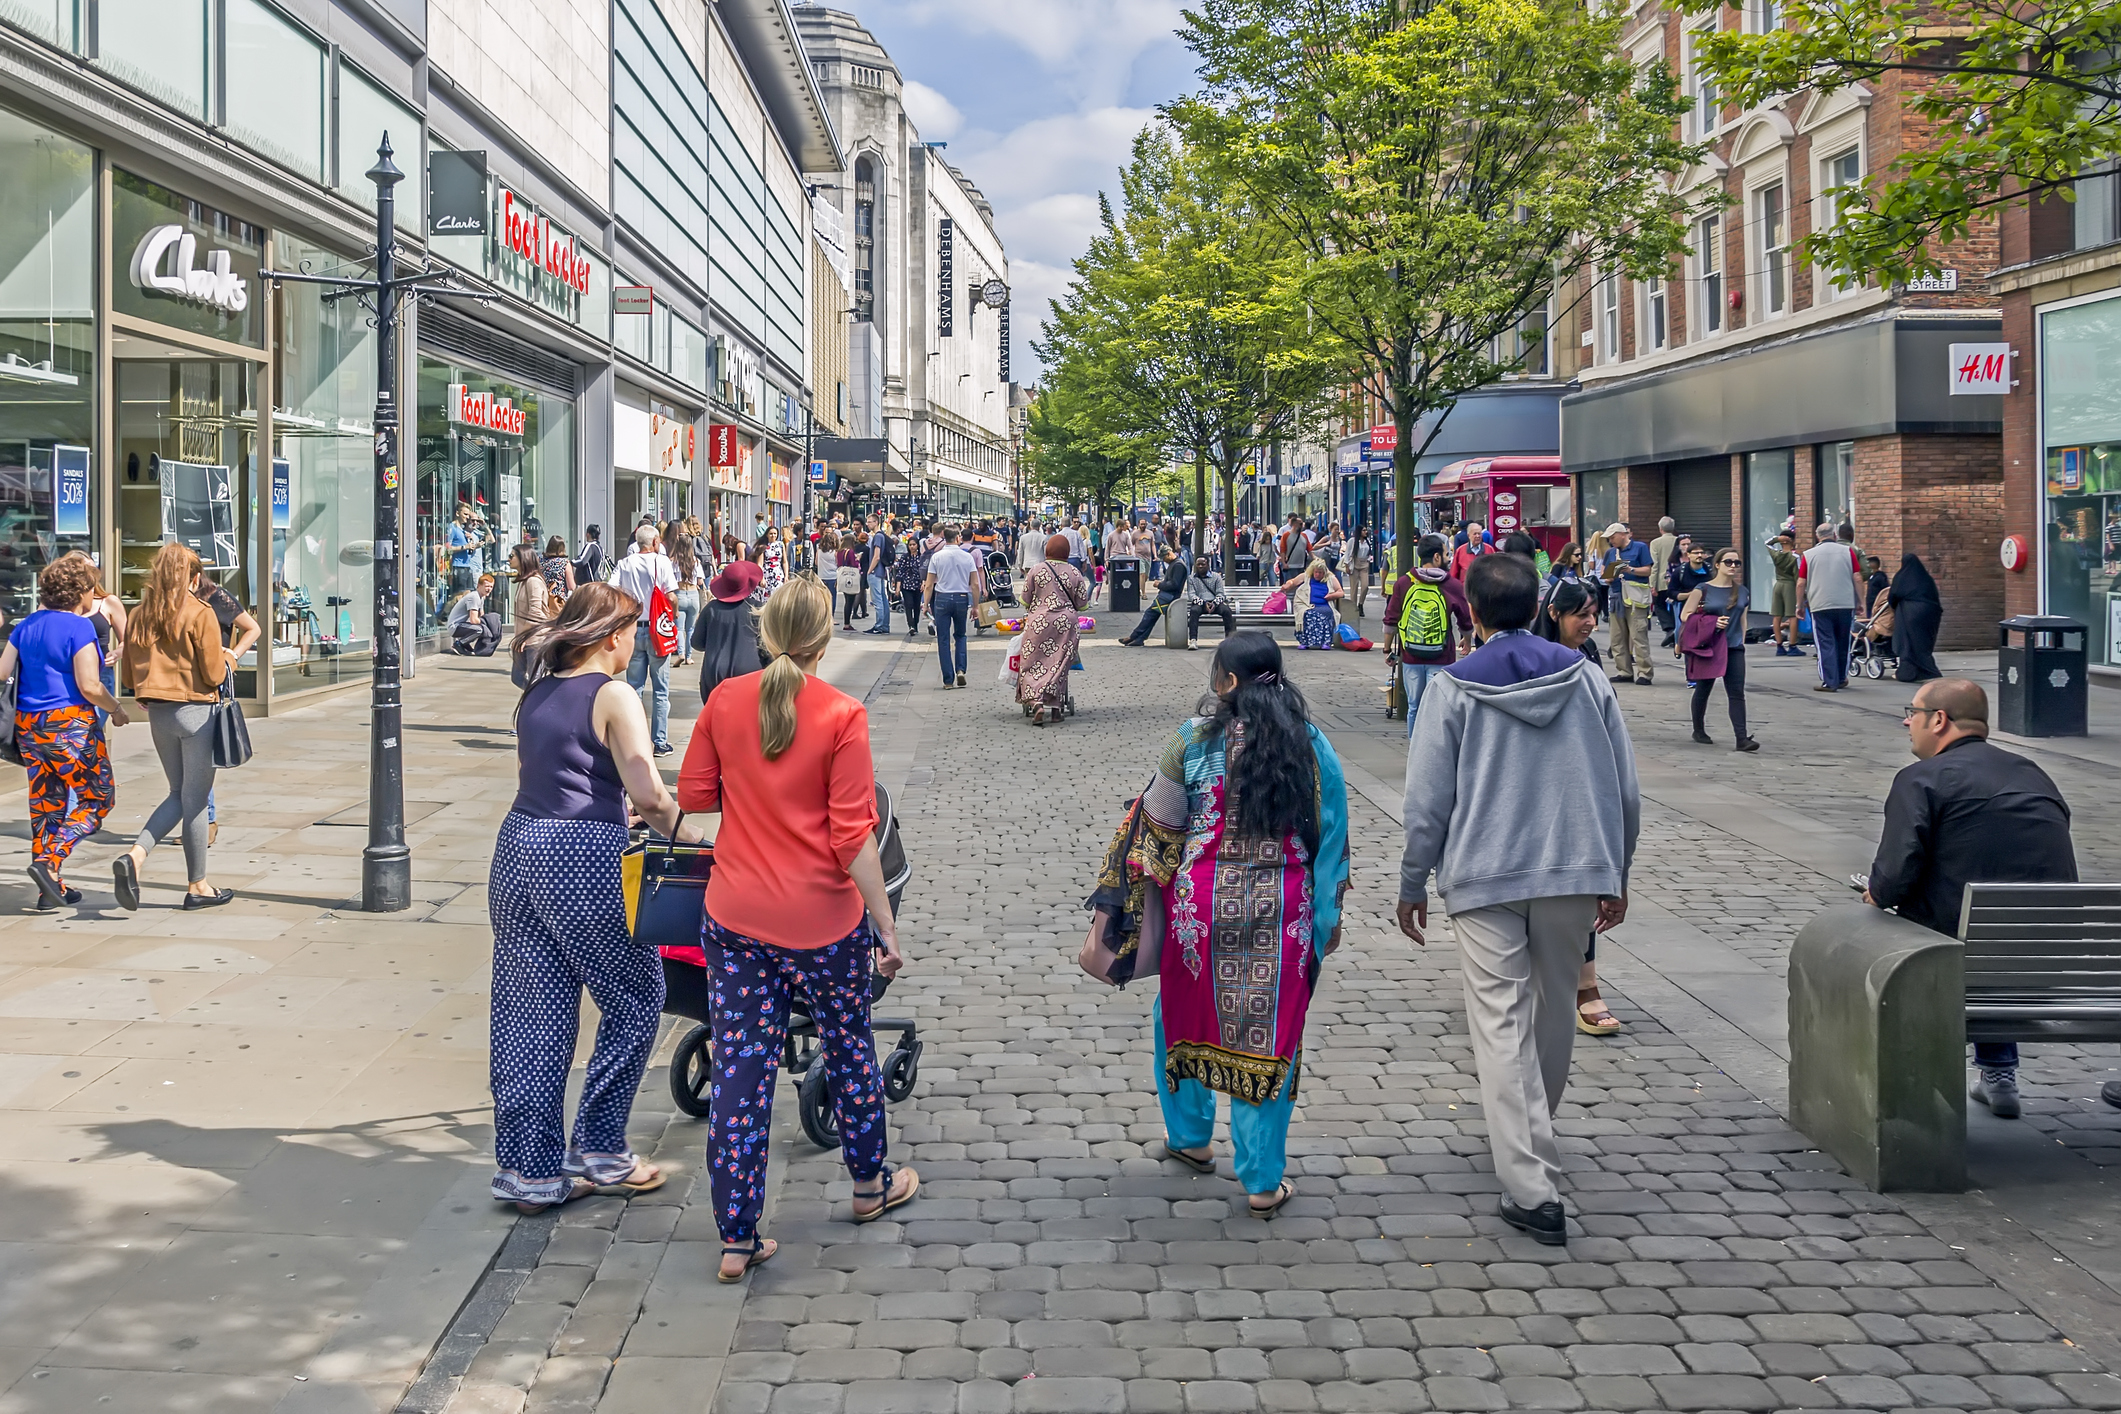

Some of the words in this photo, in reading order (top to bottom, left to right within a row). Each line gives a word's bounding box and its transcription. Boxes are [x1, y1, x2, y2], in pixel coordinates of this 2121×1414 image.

[436, 215, 481, 229] Clarks
[501, 188, 541, 268] Foot
[543, 218, 591, 297] Locker
[941, 227, 952, 329] DEBENHAMS
[1912, 280, 1951, 290] STREET
[1001, 305, 1009, 377] EBENHAMS
[1958, 353, 2005, 384] H&M
[460, 384, 486, 427] Foot
[489, 393, 526, 435] Locker
[1373, 436, 1385, 444] TO
[63, 468, 84, 478] SANDALS
[62, 482, 84, 505] 50%
